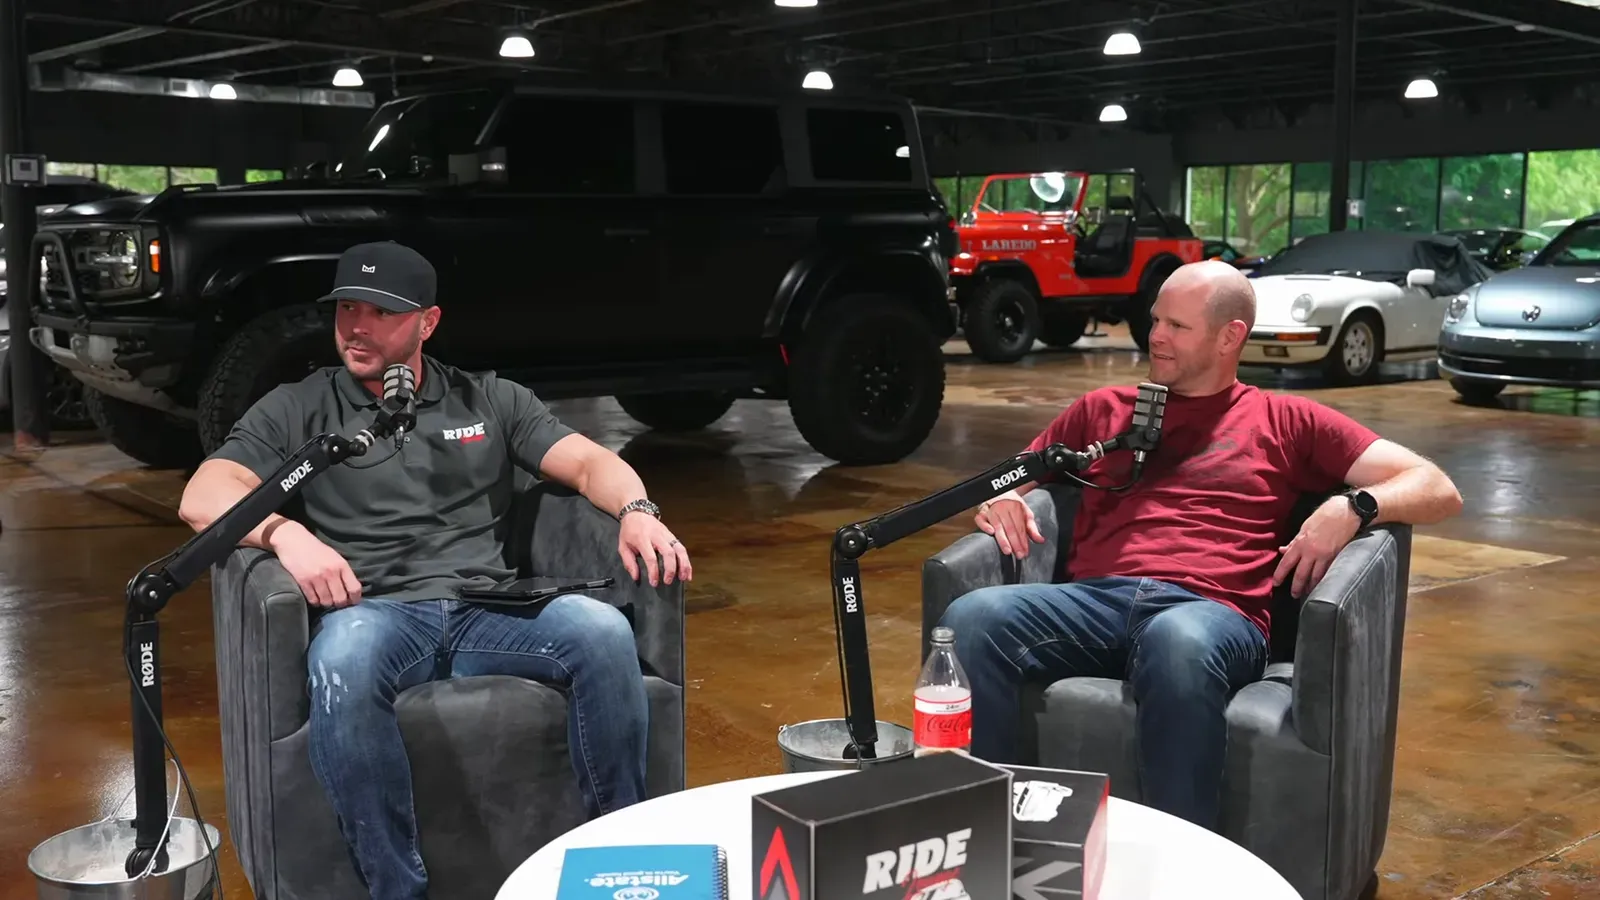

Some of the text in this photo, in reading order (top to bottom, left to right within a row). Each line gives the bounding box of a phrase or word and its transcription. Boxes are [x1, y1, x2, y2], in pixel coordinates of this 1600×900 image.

[982, 240, 1037, 251] LAREDO
[442, 421, 485, 440] RIDE
[862, 827, 972, 894] RIDE
[589, 874, 689, 888] Allstate
